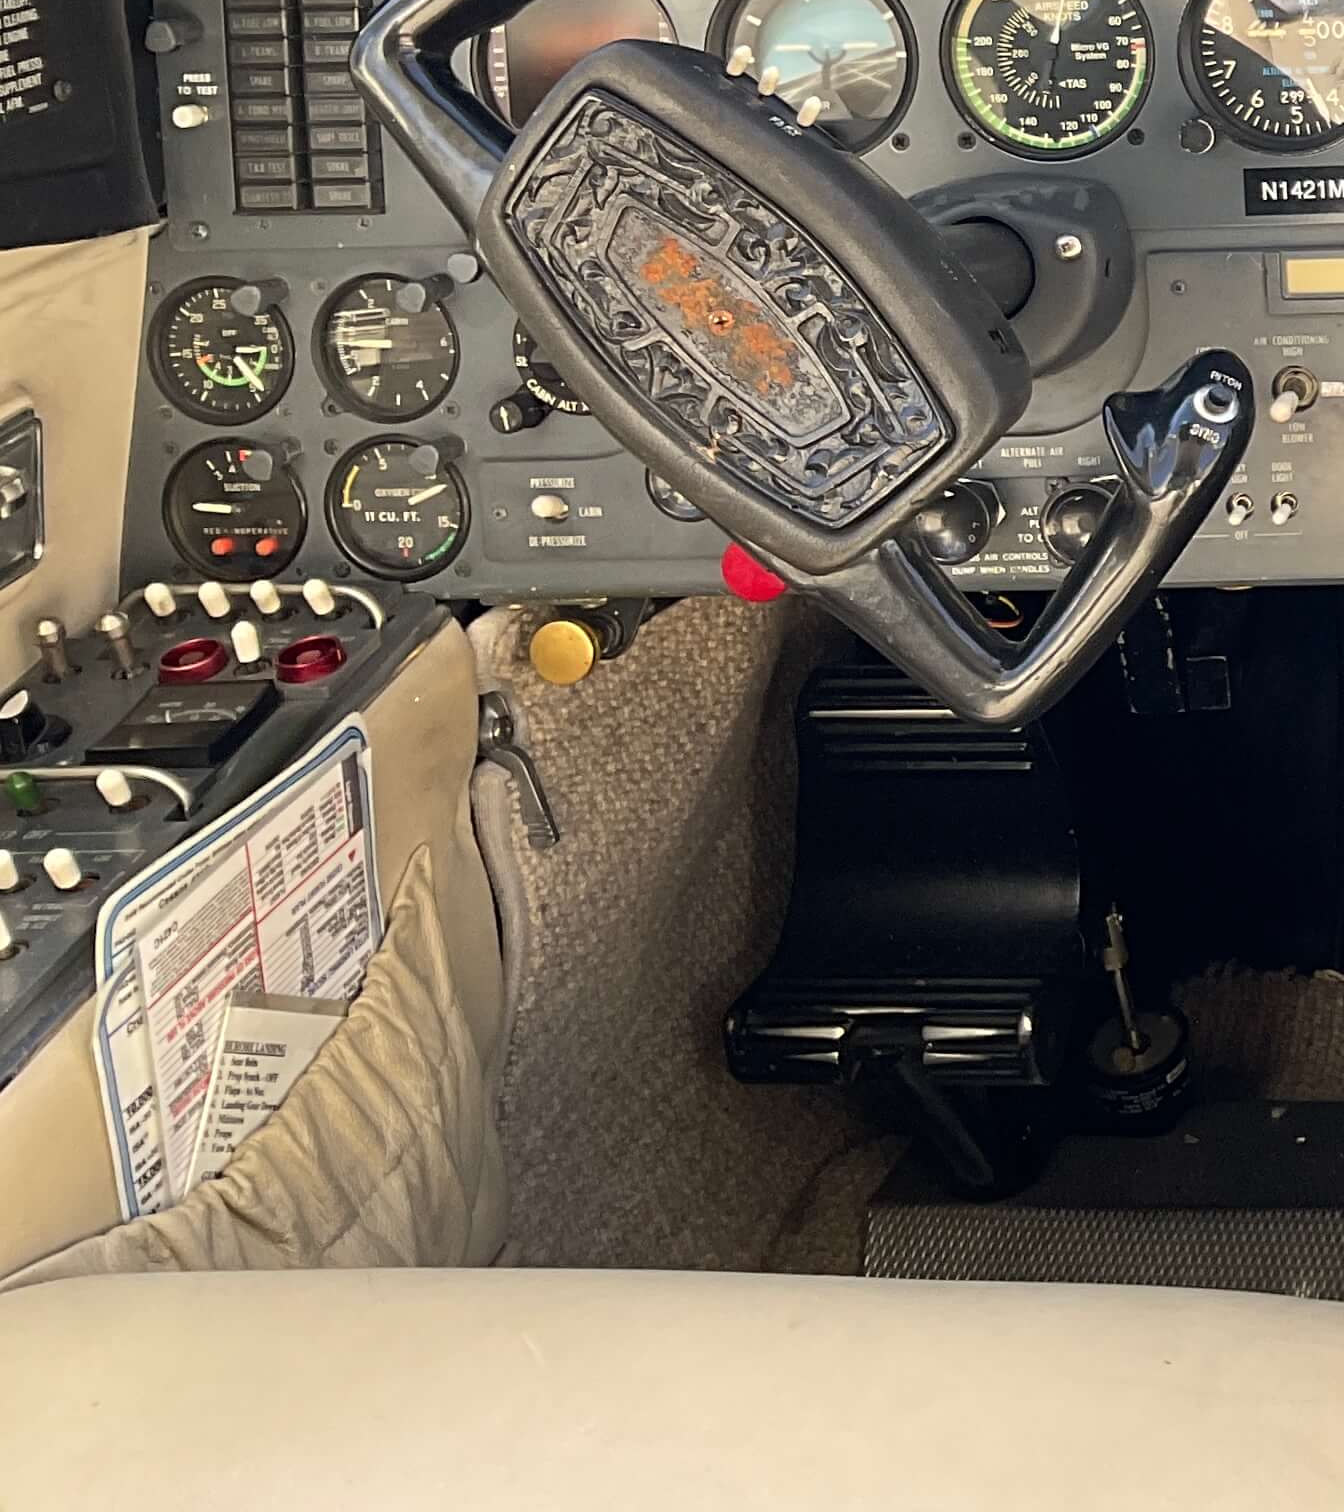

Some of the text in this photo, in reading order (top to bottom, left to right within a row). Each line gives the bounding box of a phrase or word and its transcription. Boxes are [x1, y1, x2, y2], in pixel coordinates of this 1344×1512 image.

[1001, 447, 1063, 457] ALTERNATE AIR
[530, 477, 575, 488] PRESSURIZE
[378, 512, 401, 522] CU.
[403, 512, 421, 522] FT.
